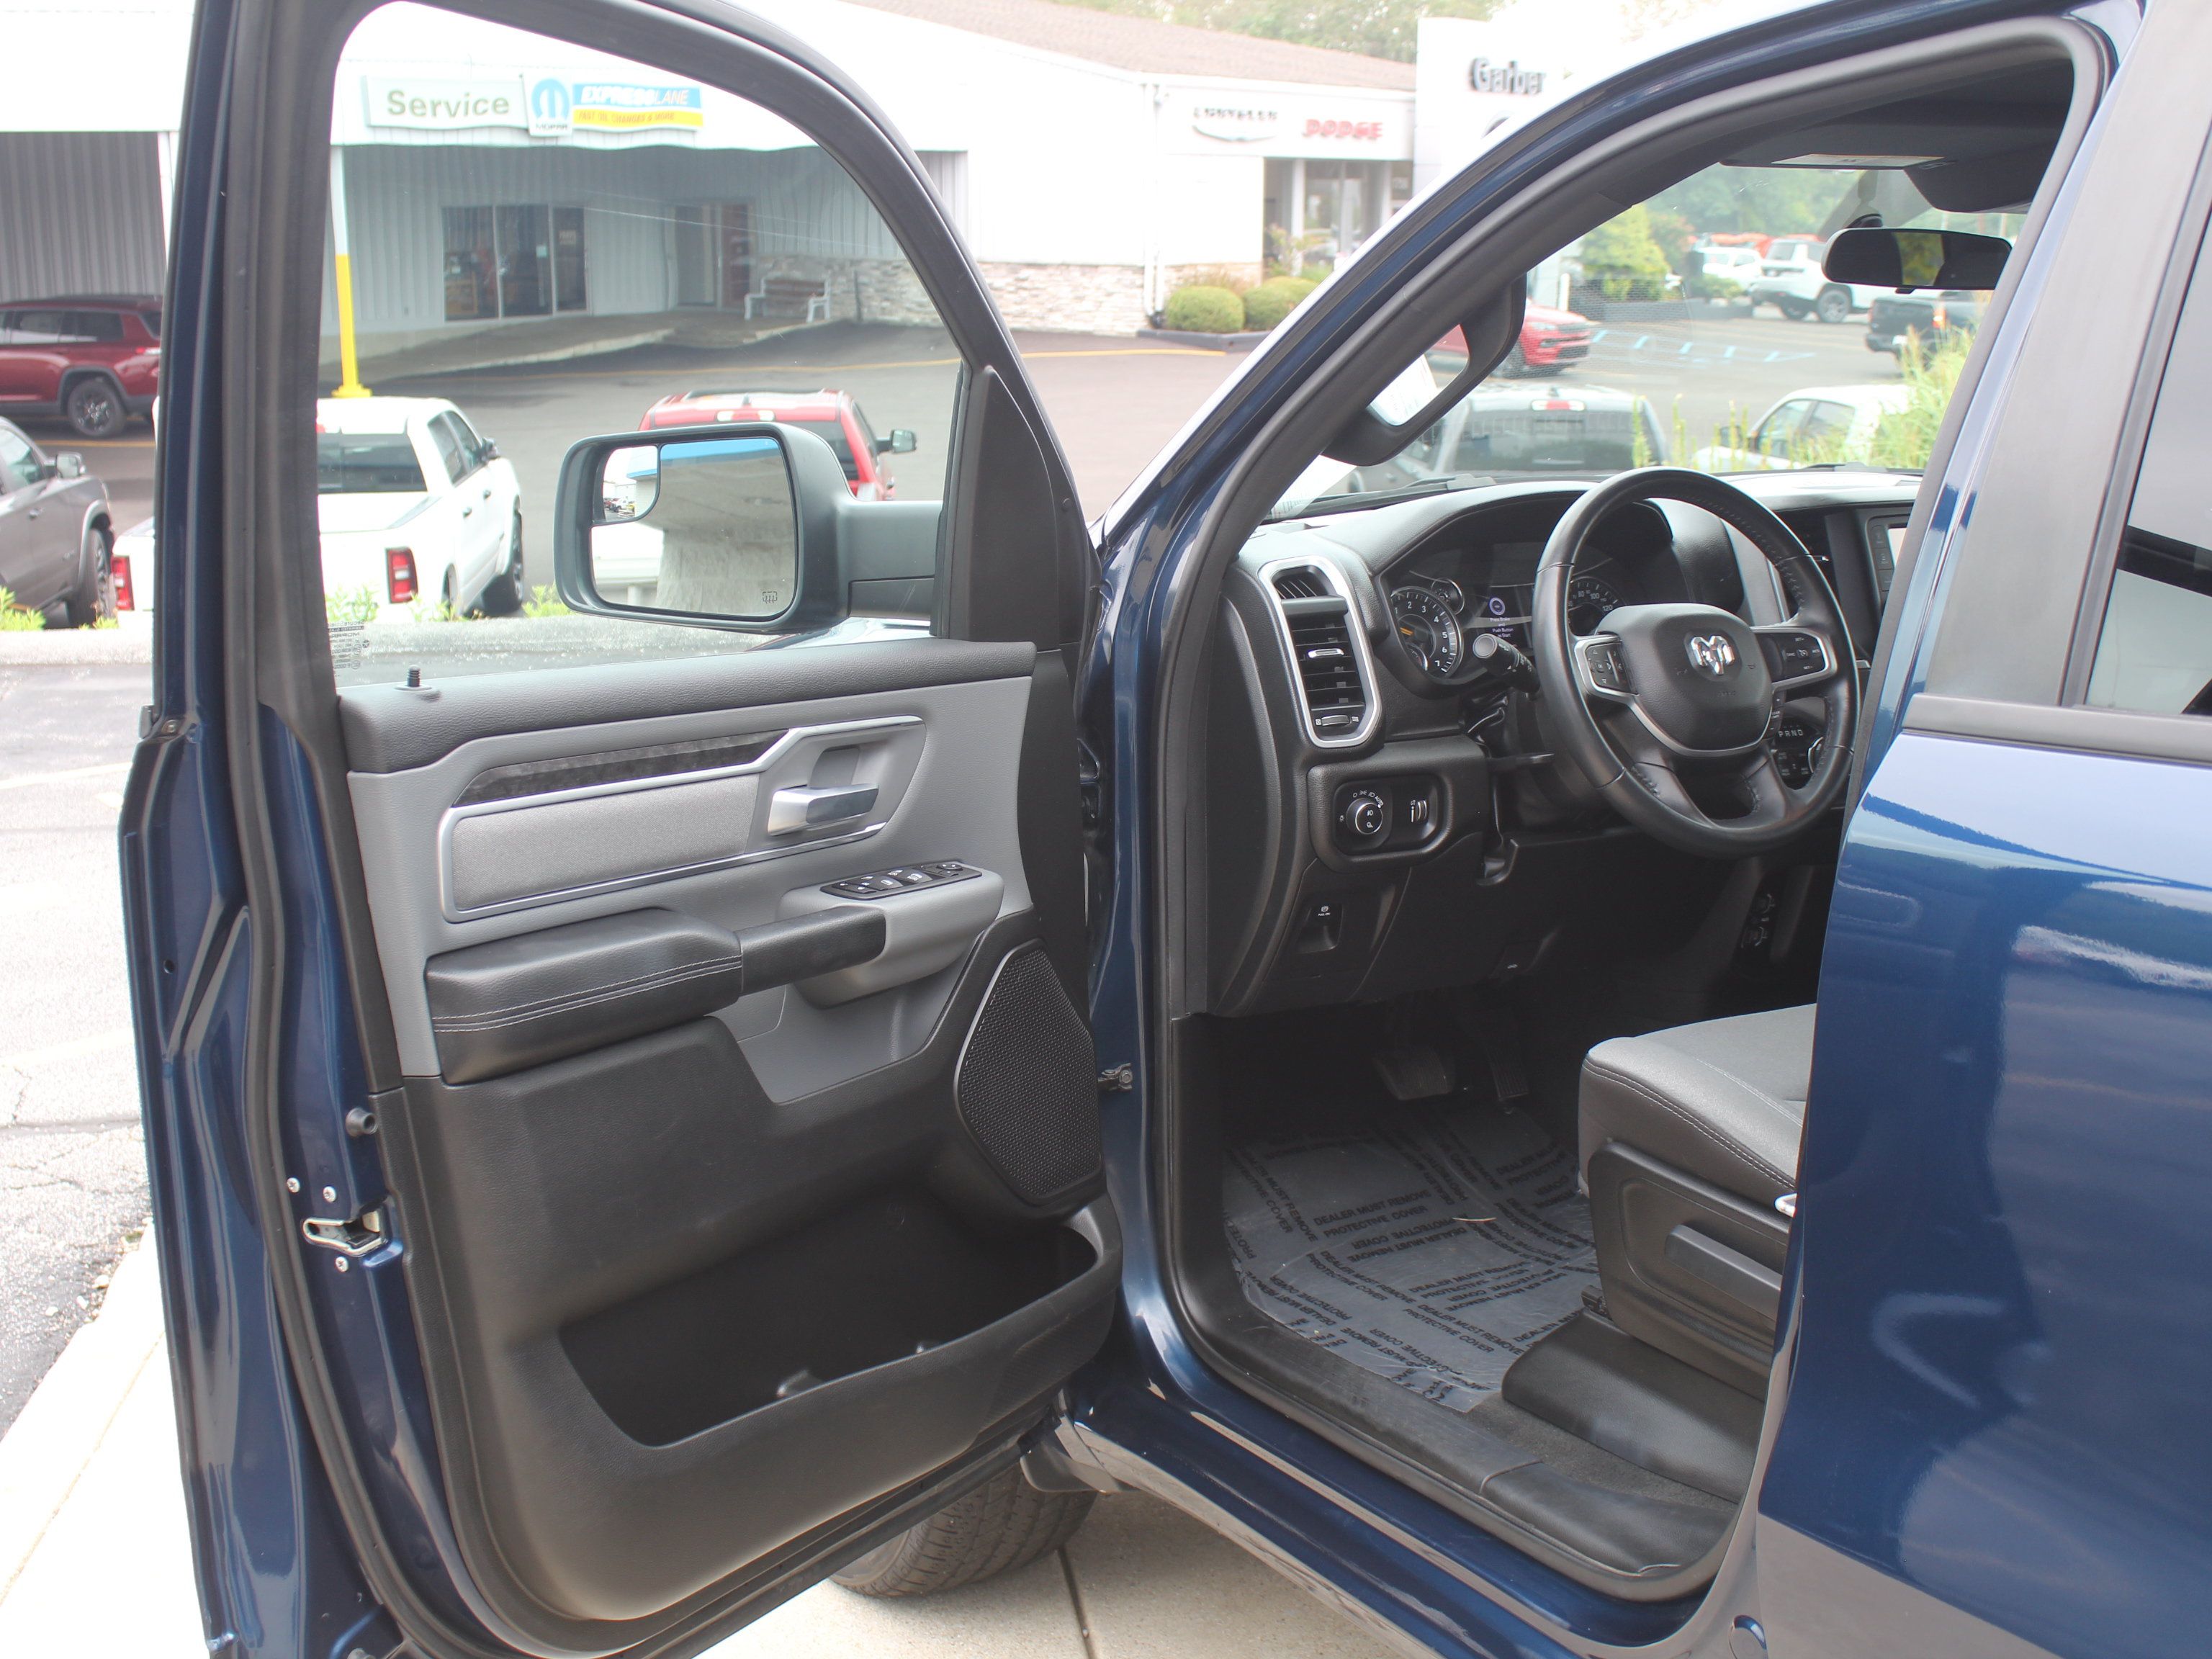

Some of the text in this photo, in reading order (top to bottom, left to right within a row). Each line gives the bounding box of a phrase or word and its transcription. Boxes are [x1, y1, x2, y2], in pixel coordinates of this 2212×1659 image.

[387, 90, 509, 118] Service
[1303, 119, 1382, 140] DODGE
[1407, 601, 1412, 609] 2
[1496, 1154, 1534, 1176] DEALER
[1264, 1176, 1290, 1201] MUST
[1285, 1202, 1319, 1242] REMOVE
[1266, 1199, 1295, 1233] COVER
[1313, 1189, 1431, 1226] DEALER MUST REMOVE
[1323, 1205, 1429, 1238] PROTECTIVE COVER
[1346, 1226, 1467, 1263] DEALER MUST REMOVE
[1351, 1235, 1390, 1249] COVER
[1306, 1253, 1388, 1301] PROTECTIVE COVER
[1320, 1251, 1417, 1304] DEALER MUST REMOVE
[1408, 1277, 1452, 1293] DEALER
[1452, 1270, 1484, 1283] MUST
[1269, 1274, 1353, 1321] PROTECTIVE COVER
[1275, 1292, 1302, 1308] MUST
[1447, 1289, 1487, 1302] COVER
[1300, 1305, 1337, 1326] DEALER
[1340, 1327, 1382, 1347] REMOVE
[1370, 1328, 1405, 1346] COVER
[1403, 1308, 1496, 1354] PROTECTIVE COVER
[1417, 1303, 1455, 1321] DEALER
[1453, 1319, 1486, 1334] MUST
[1480, 1331, 1526, 1355] REMOVE
[1513, 1320, 1556, 1342] DEALER
